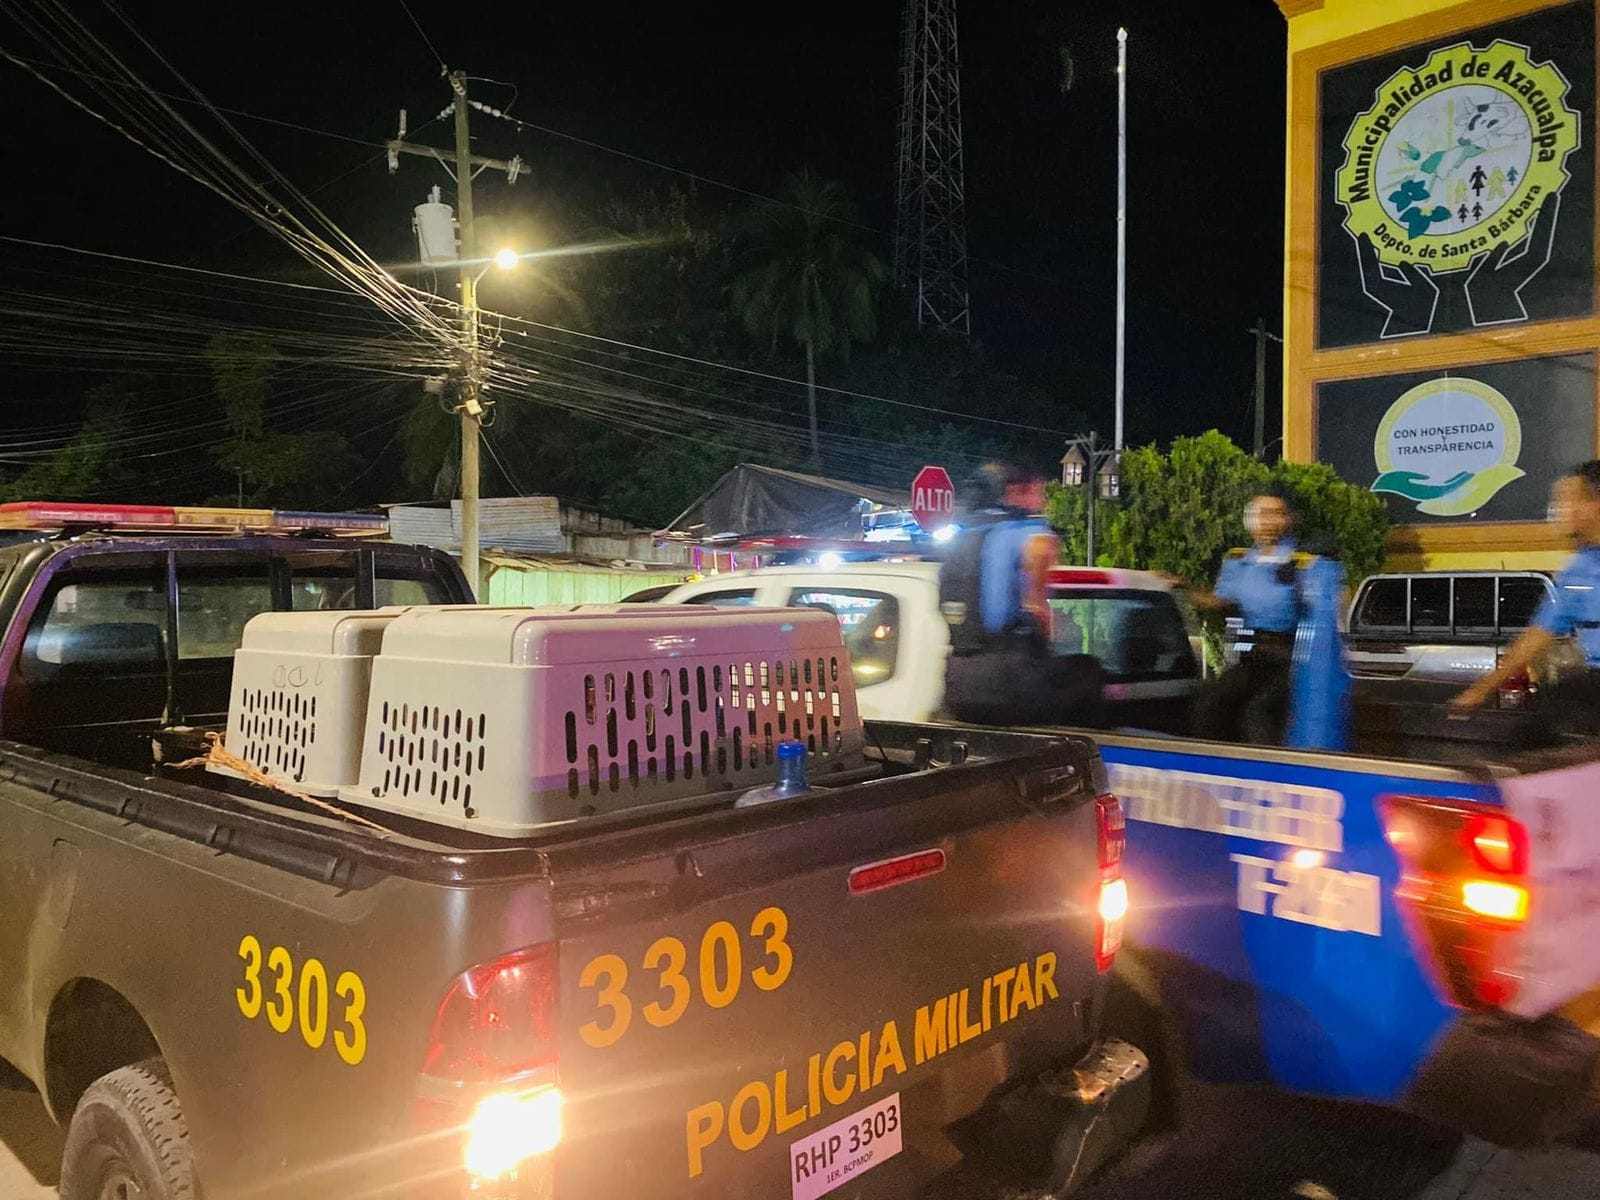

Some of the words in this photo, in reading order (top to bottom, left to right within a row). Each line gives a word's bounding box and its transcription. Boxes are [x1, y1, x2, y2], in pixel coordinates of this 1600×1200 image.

[1349, 61, 1453, 203] Municipalidad
[1460, 55, 1490, 78] de
[1493, 60, 1565, 163] Azacualpa
[1374, 223, 1414, 256] Depto.
[1418, 244, 1437, 258] de
[1441, 236, 1487, 258] Santa
[1487, 184, 1542, 239] Bárbara
[1393, 428, 1417, 439] CON
[1420, 422, 1495, 437] HONESTIDAD
[1397, 440, 1494, 456] TRANSPARENCIA
[915, 487, 953, 513] ALTO
[236, 935, 367, 1065] 3303
[578, 906, 793, 1049] 3303
[686, 1020, 907, 1178] POLICIA
[914, 951, 1059, 1066] MILITAR
[795, 1135, 841, 1183] RHP
[848, 1104, 898, 1153] 3303
